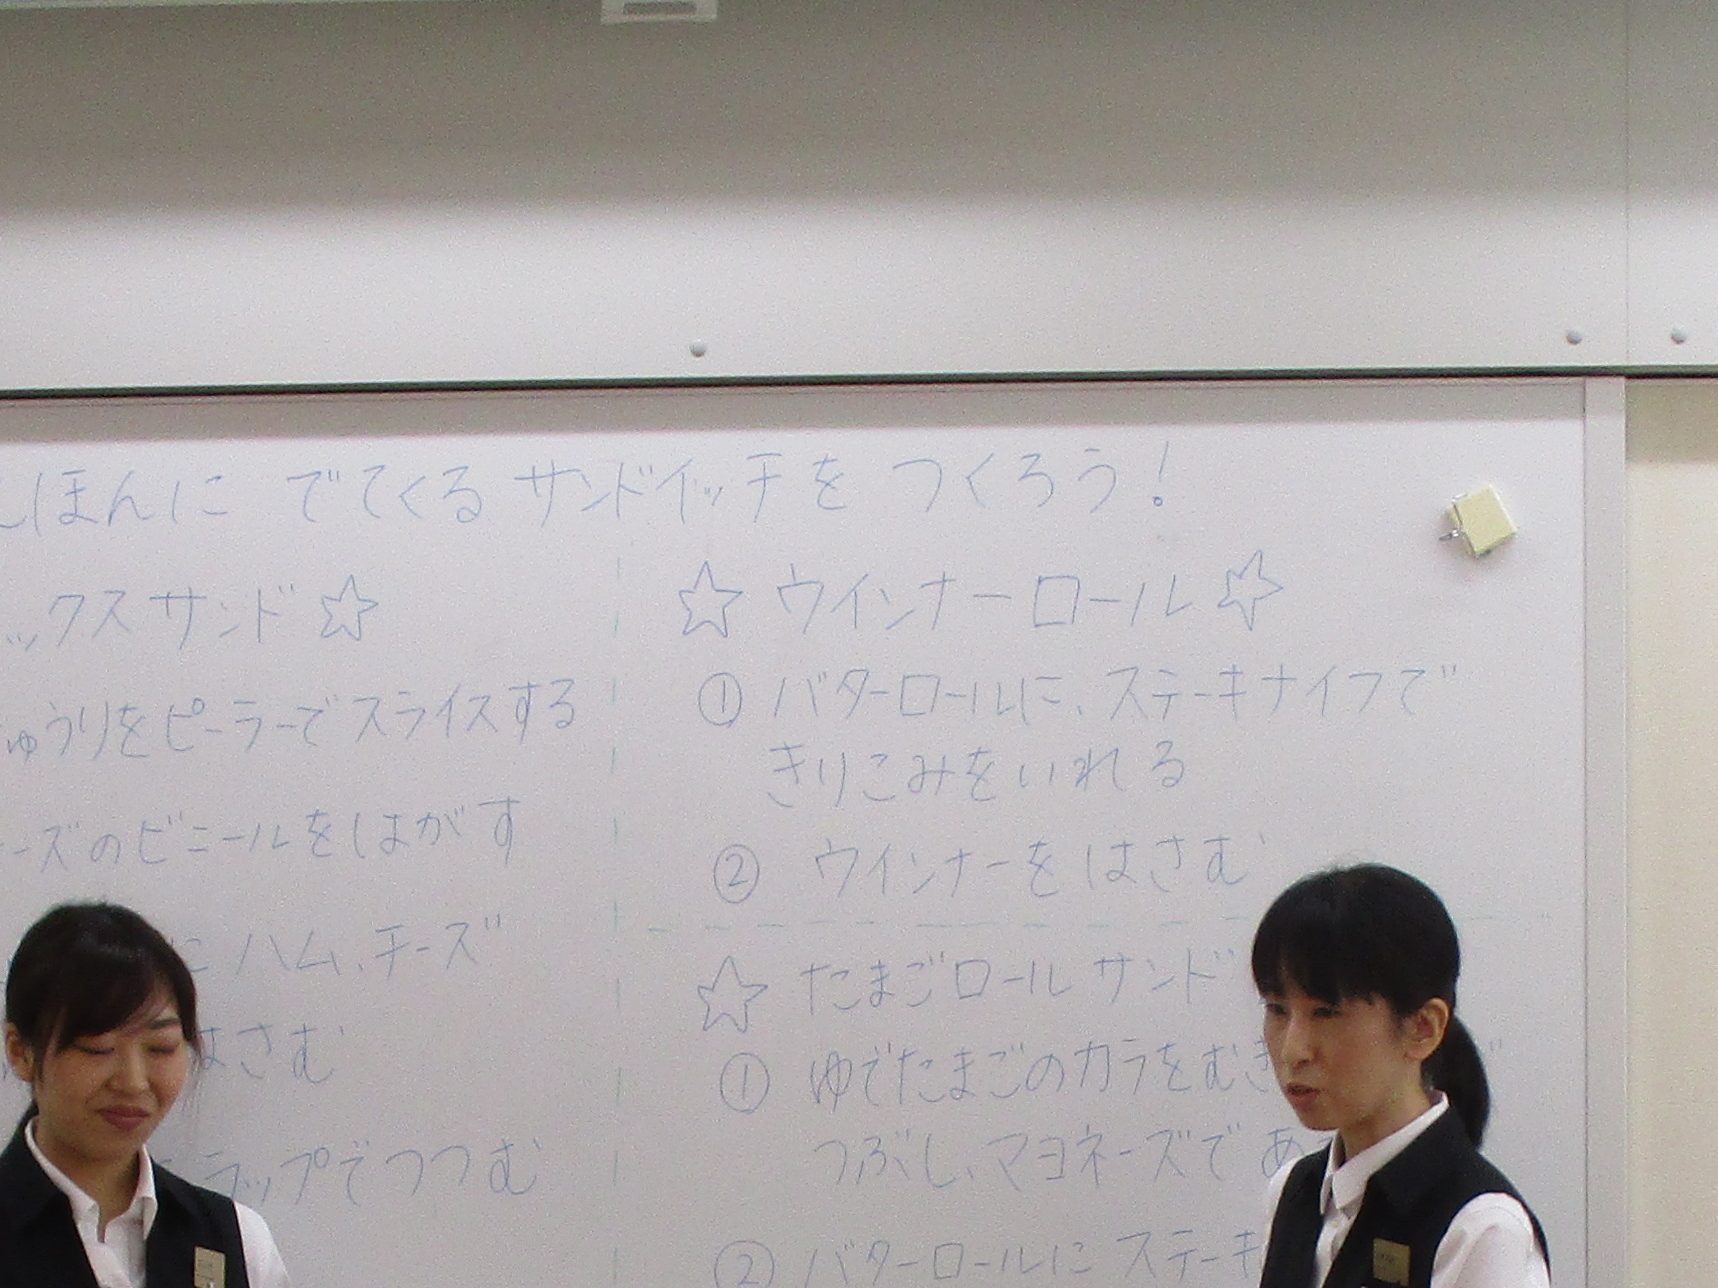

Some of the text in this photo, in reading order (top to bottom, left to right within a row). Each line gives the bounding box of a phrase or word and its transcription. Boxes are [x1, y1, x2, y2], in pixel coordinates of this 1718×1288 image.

[284, 462, 484, 526] でてくる
[512, 451, 848, 529] サンドイッチを
[774, 562, 1194, 636] ウインナーロール
[766, 738, 1187, 810] きりこみをいれる
